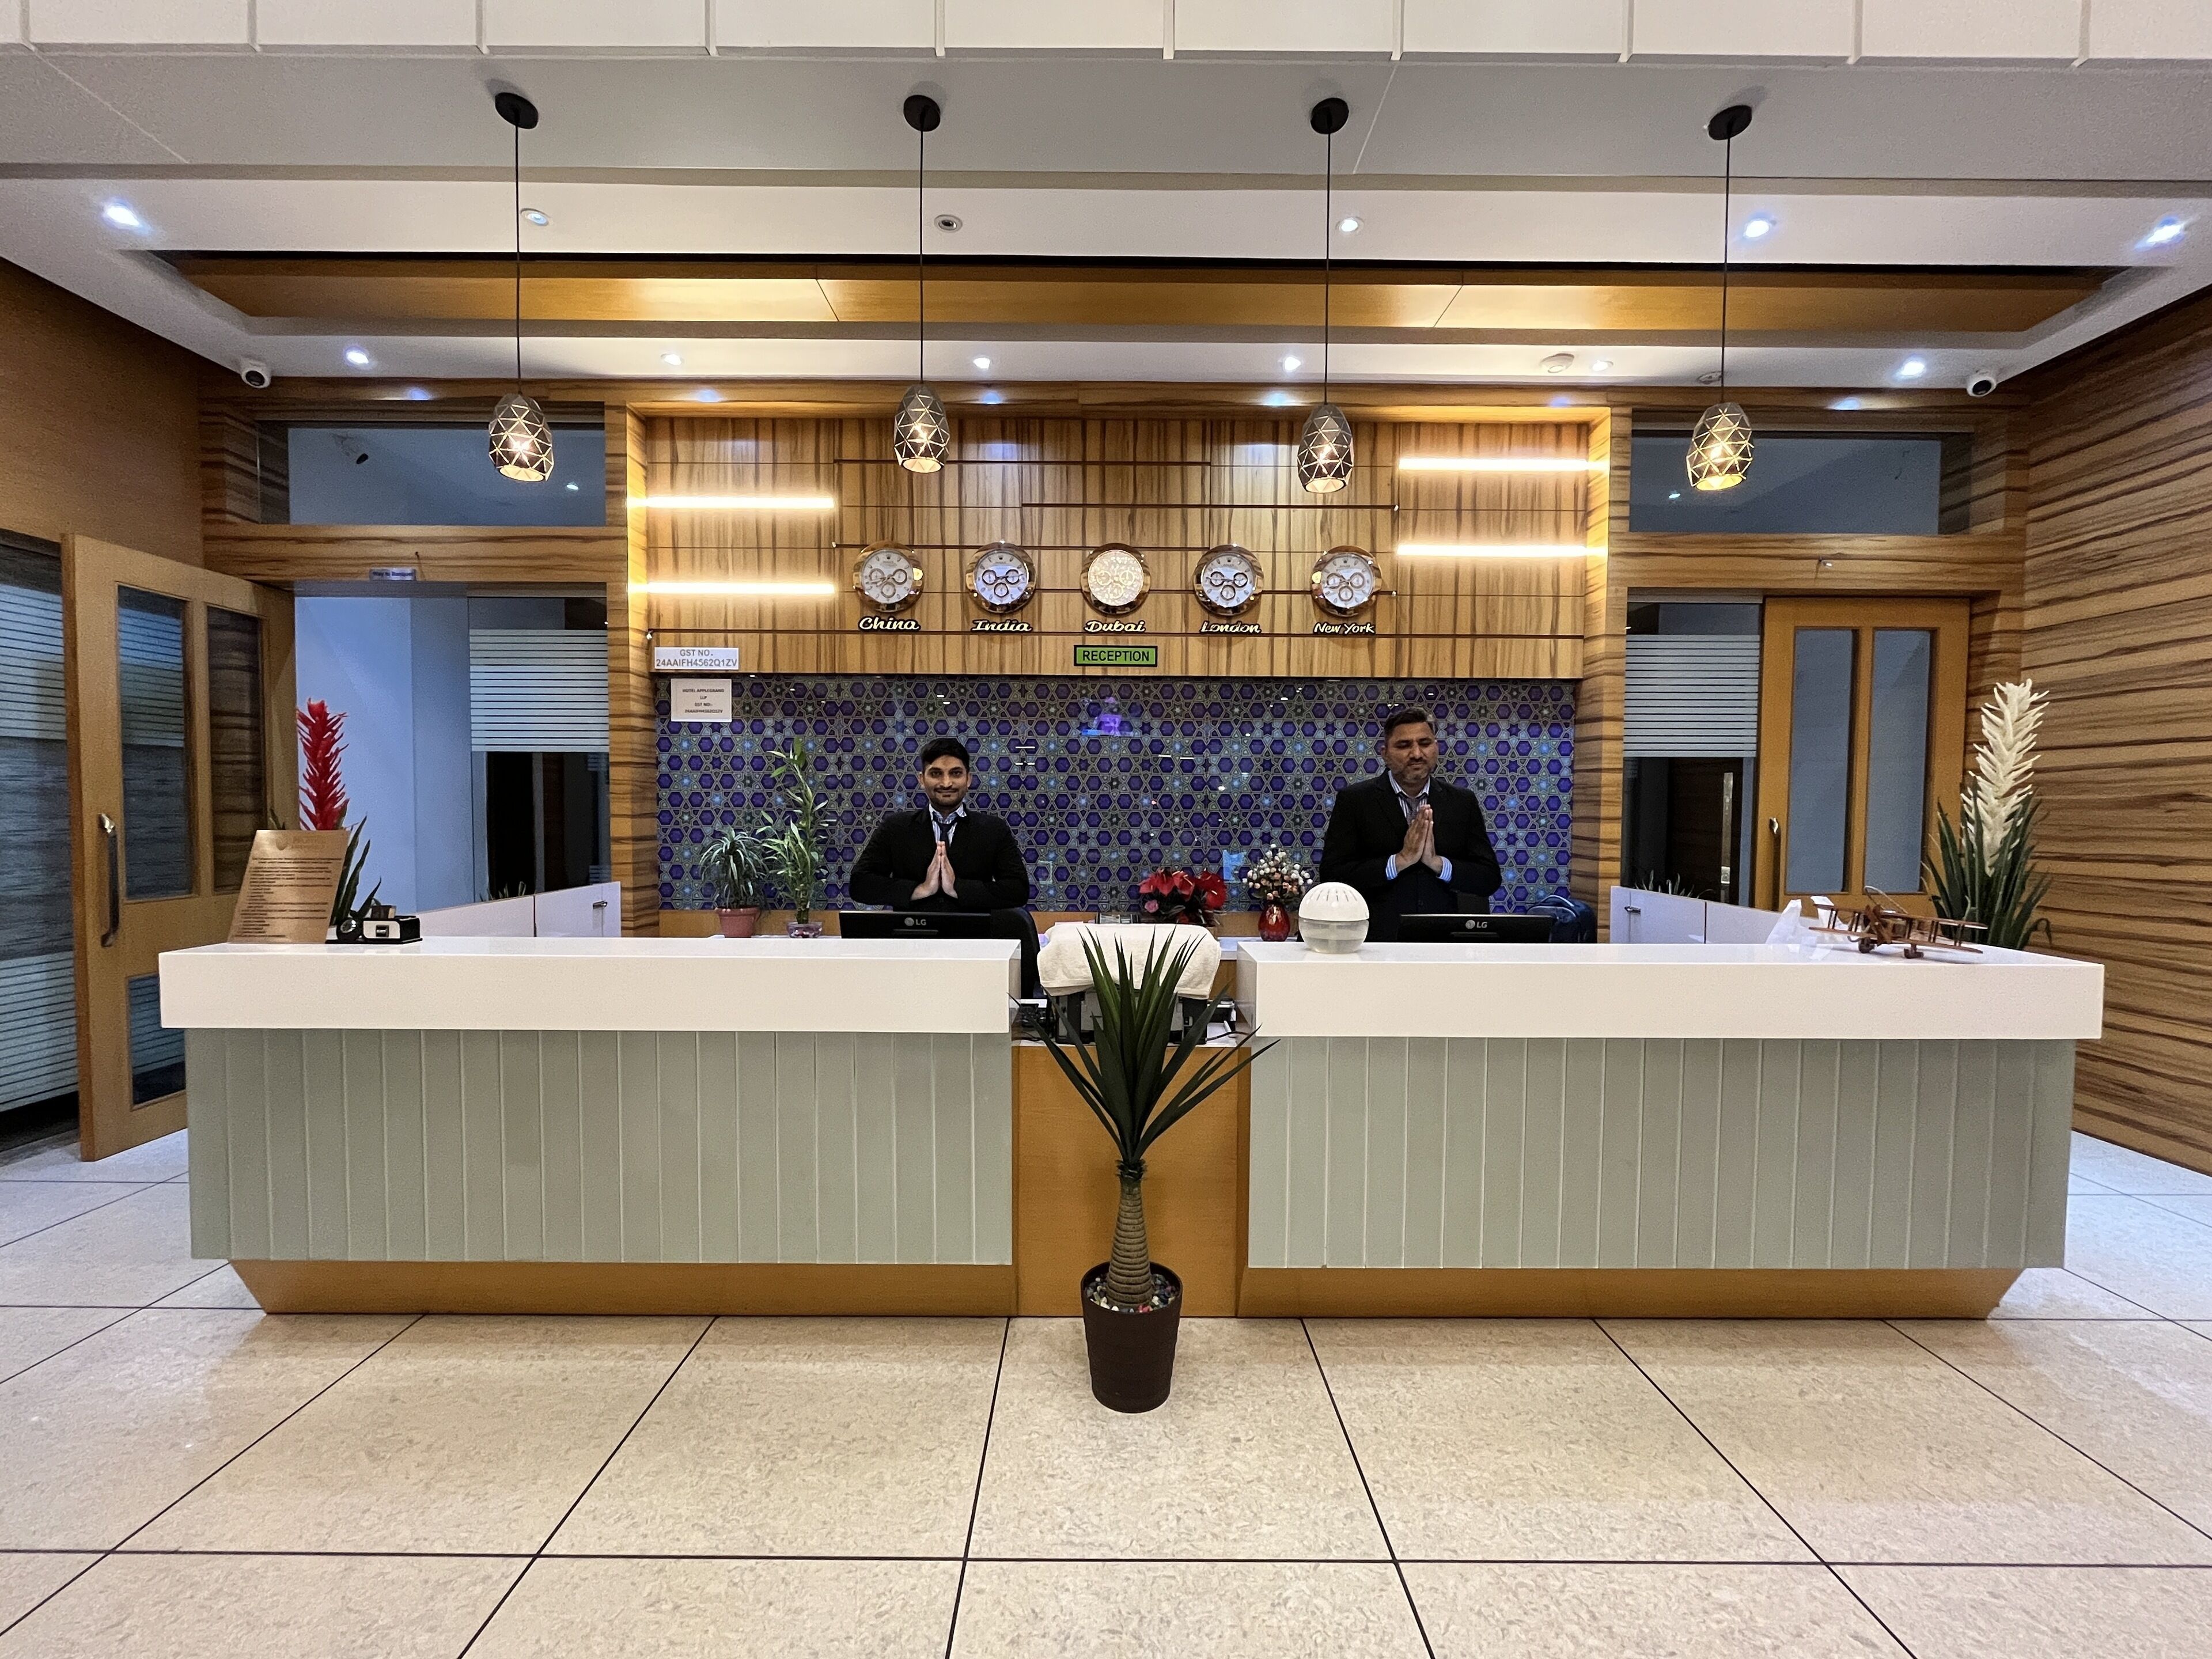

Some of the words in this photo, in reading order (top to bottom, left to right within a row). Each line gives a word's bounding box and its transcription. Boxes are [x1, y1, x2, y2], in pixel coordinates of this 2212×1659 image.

[858, 616, 920, 630] China
[972, 620, 1032, 632] India
[1085, 620, 1146, 632] Dubai
[1201, 621, 1260, 633] London
[1313, 623, 1341, 633] New
[1343, 623, 1375, 634] York
[1082, 650, 1149, 662] RECEPTION
